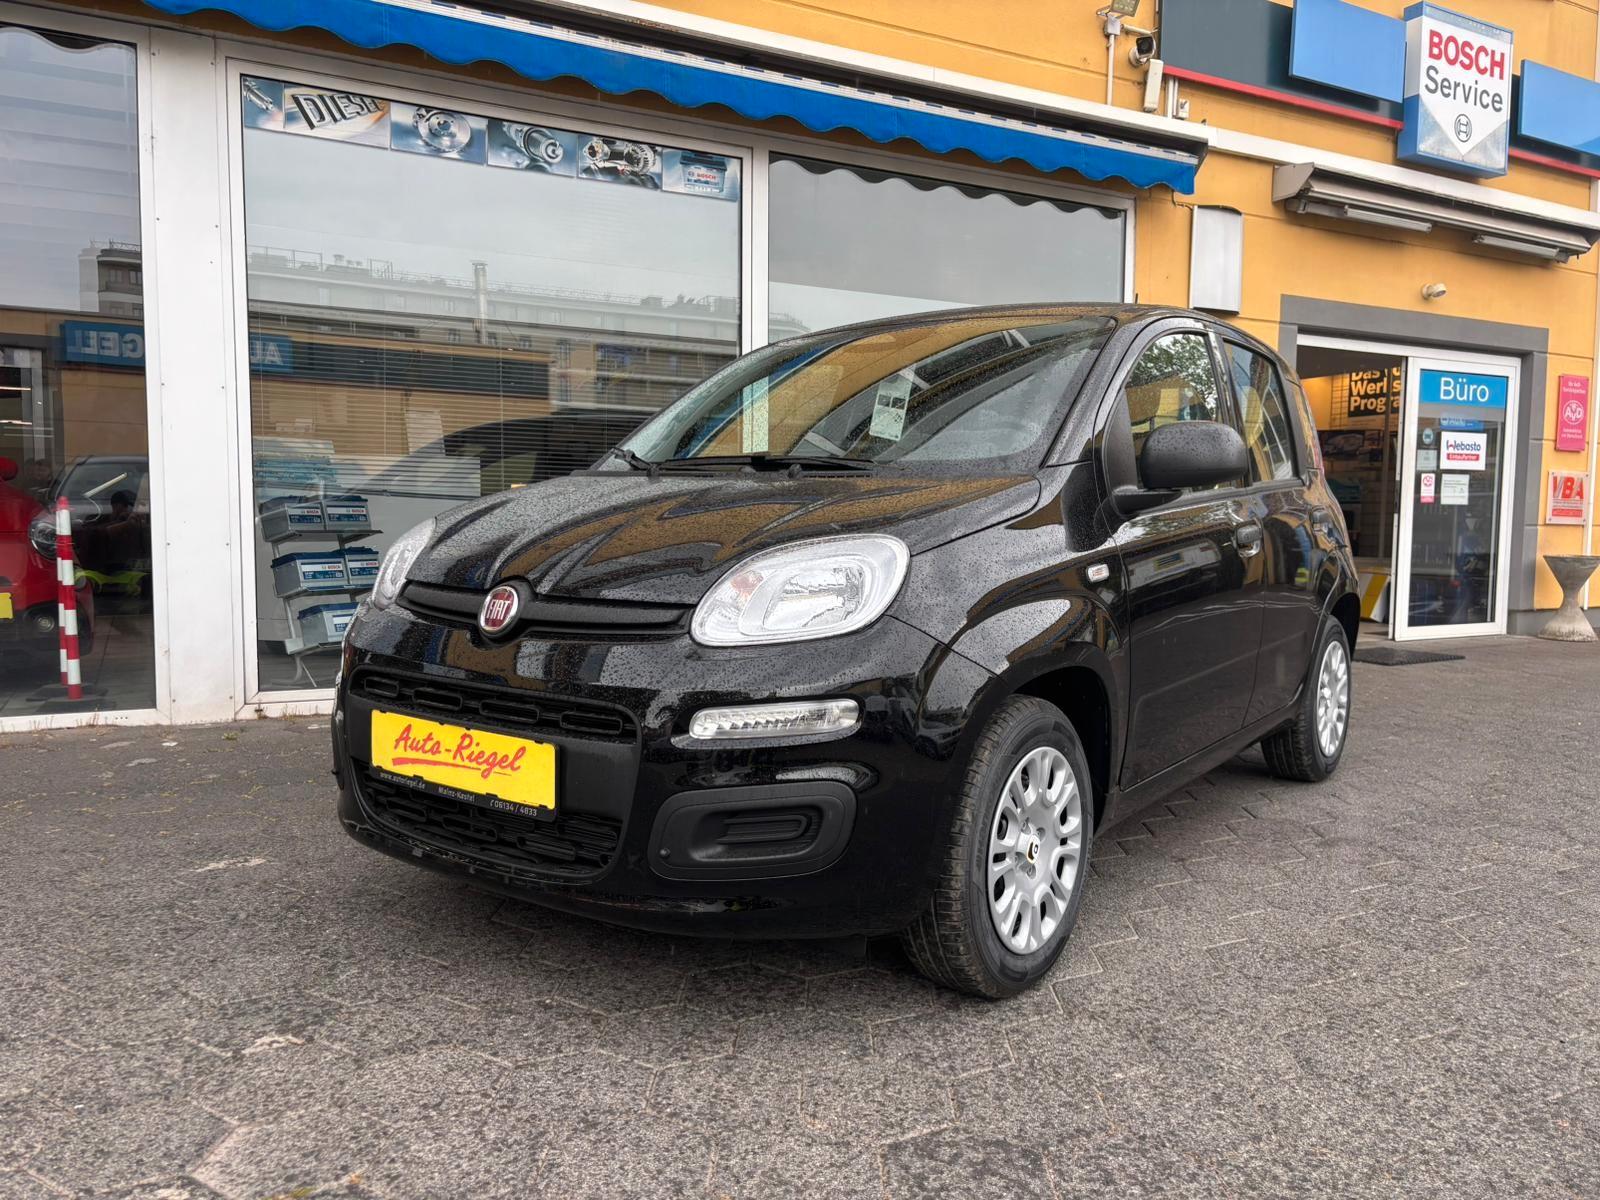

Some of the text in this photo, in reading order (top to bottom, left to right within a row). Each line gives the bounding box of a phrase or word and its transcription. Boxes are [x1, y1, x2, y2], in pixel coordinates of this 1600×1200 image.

[1428, 29, 1505, 80] BOSCH
[1424, 65, 1503, 113] Service
[1440, 377, 1489, 402] Büro
[1446, 440, 1481, 452] Webasto
[1552, 476, 1584, 500] VBA
[486, 599, 511, 620] FIAT
[393, 723, 527, 779] Auto-Riegel
[438, 786, 475, 802] Mainz-Kastel
[494, 801, 514, 812] 06134
